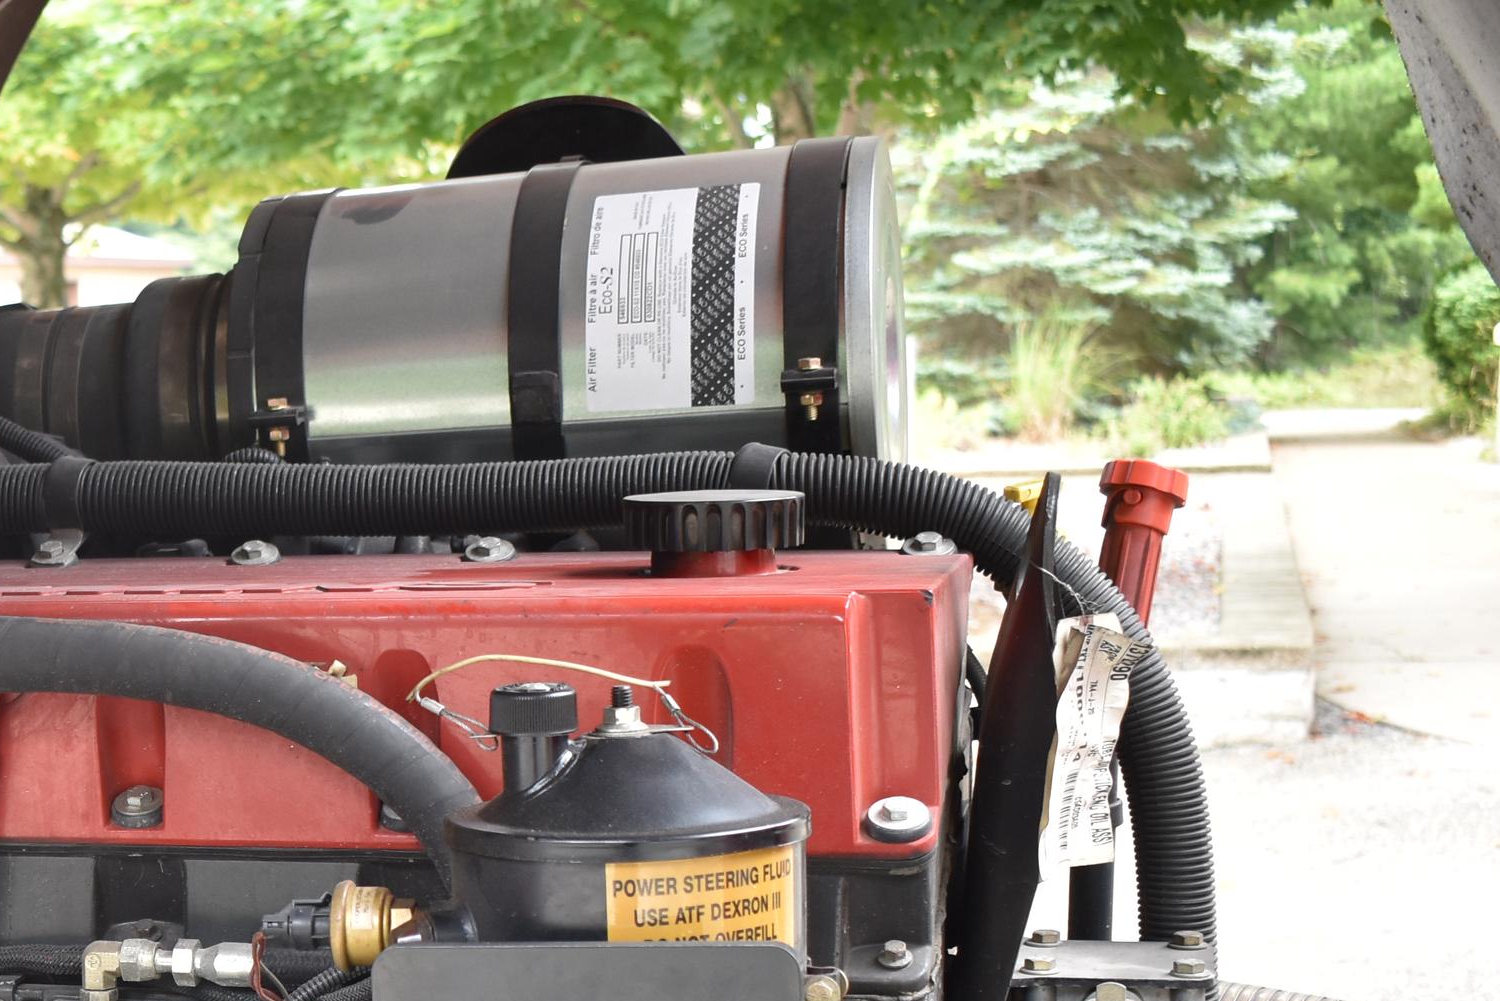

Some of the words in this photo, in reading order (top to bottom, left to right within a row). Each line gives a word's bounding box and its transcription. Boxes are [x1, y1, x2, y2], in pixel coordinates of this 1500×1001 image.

[595, 206, 605, 220] aire
[593, 222, 602, 232] de
[739, 213, 749, 239] Series
[589, 233, 601, 256] Filtro
[738, 239, 747, 258] ECO
[589, 274, 598, 286] air
[587, 296, 597, 323] Filtre
[737, 306, 746, 335] Series
[587, 347, 597, 374] Filter
[737, 338, 746, 361] ECO
[588, 379, 597, 392] Air
[612, 876, 678, 899] POWER
[682, 865, 760, 895] STEERING
[762, 857, 792, 883] FLUID
[633, 907, 670, 928] USE
[674, 904, 706, 926] ATF
[710, 895, 769, 921] DEXRON
[771, 891, 782, 909] III
